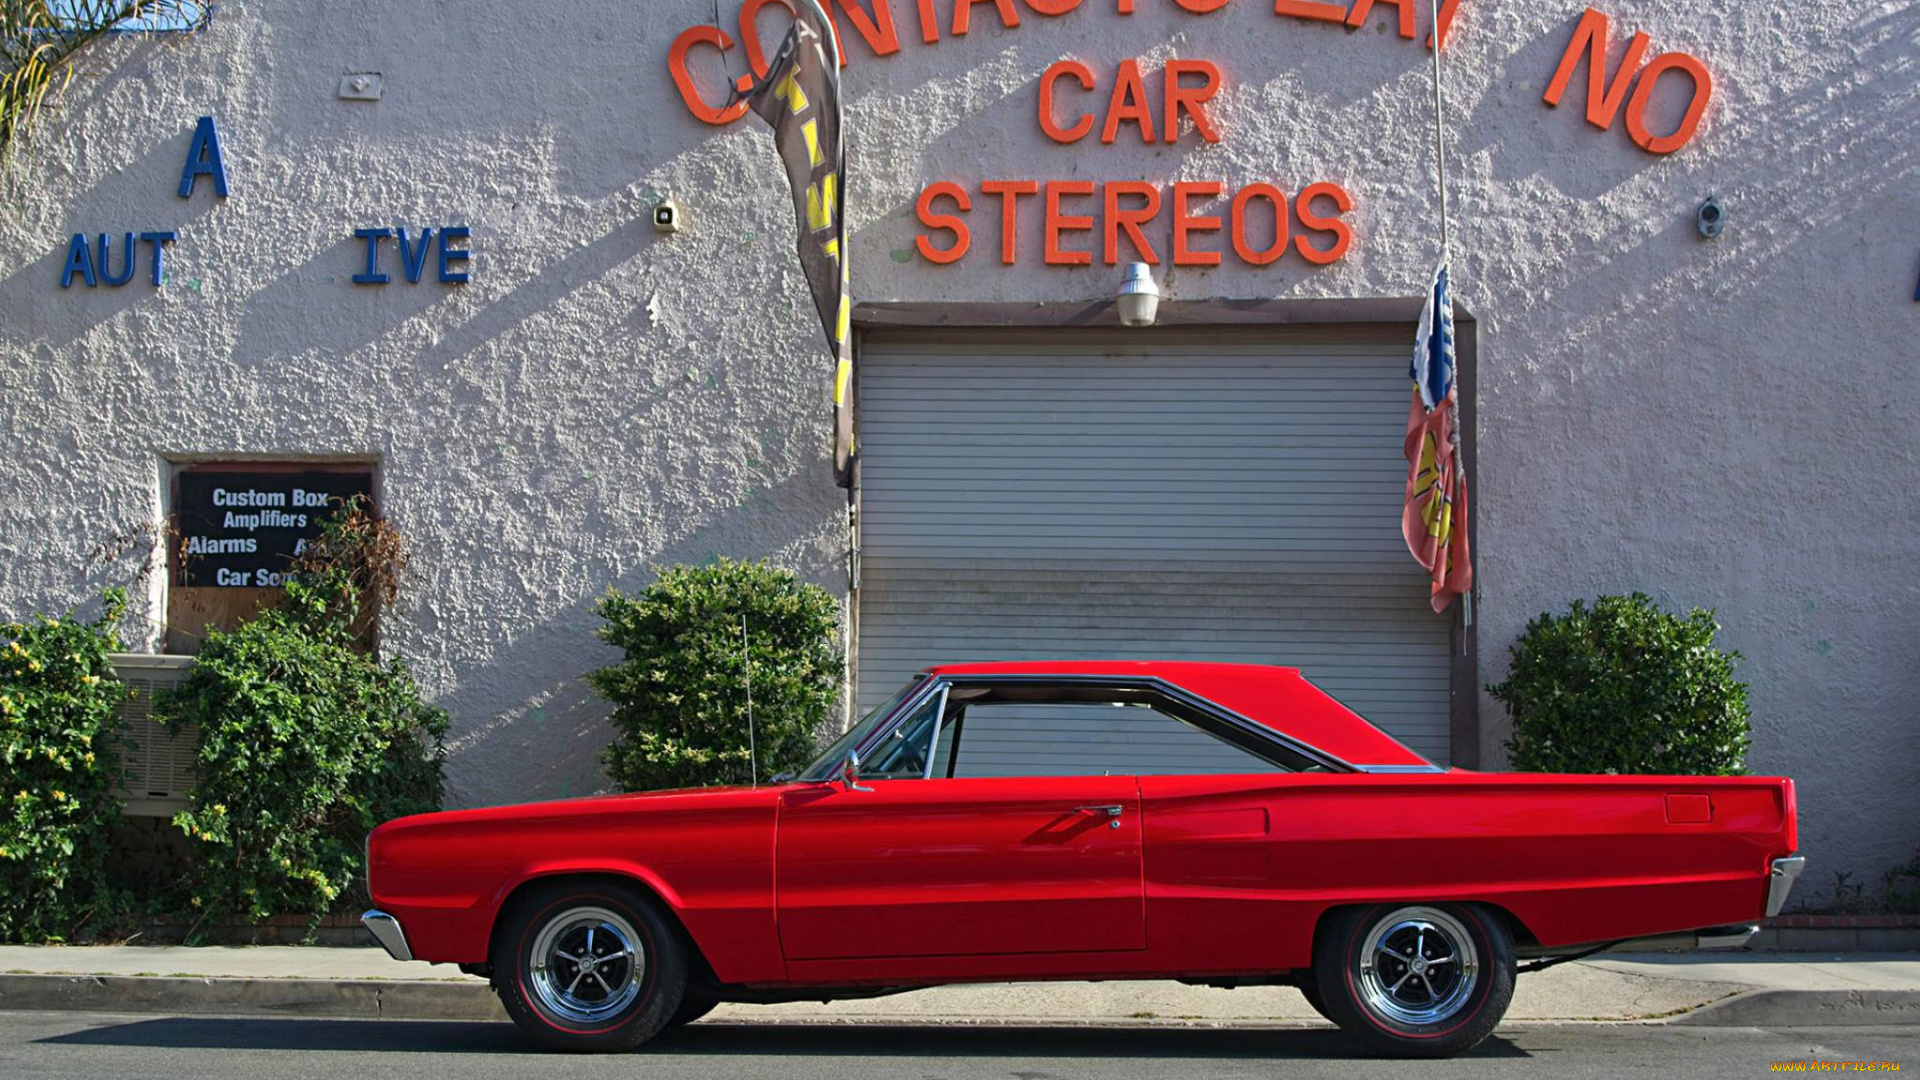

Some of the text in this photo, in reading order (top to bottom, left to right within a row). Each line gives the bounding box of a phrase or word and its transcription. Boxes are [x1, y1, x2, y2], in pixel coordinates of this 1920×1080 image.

[1038, 60, 1221, 144] CAR
[178, 116, 228, 197] A
[915, 181, 1352, 265] STEREOS
[60, 226, 471, 288] AUT IVE
[212, 488, 329, 507] Custom Box
[223, 509, 308, 532] Amplifiers
[187, 535, 257, 554] Alarms
[217, 567, 251, 586] Car
